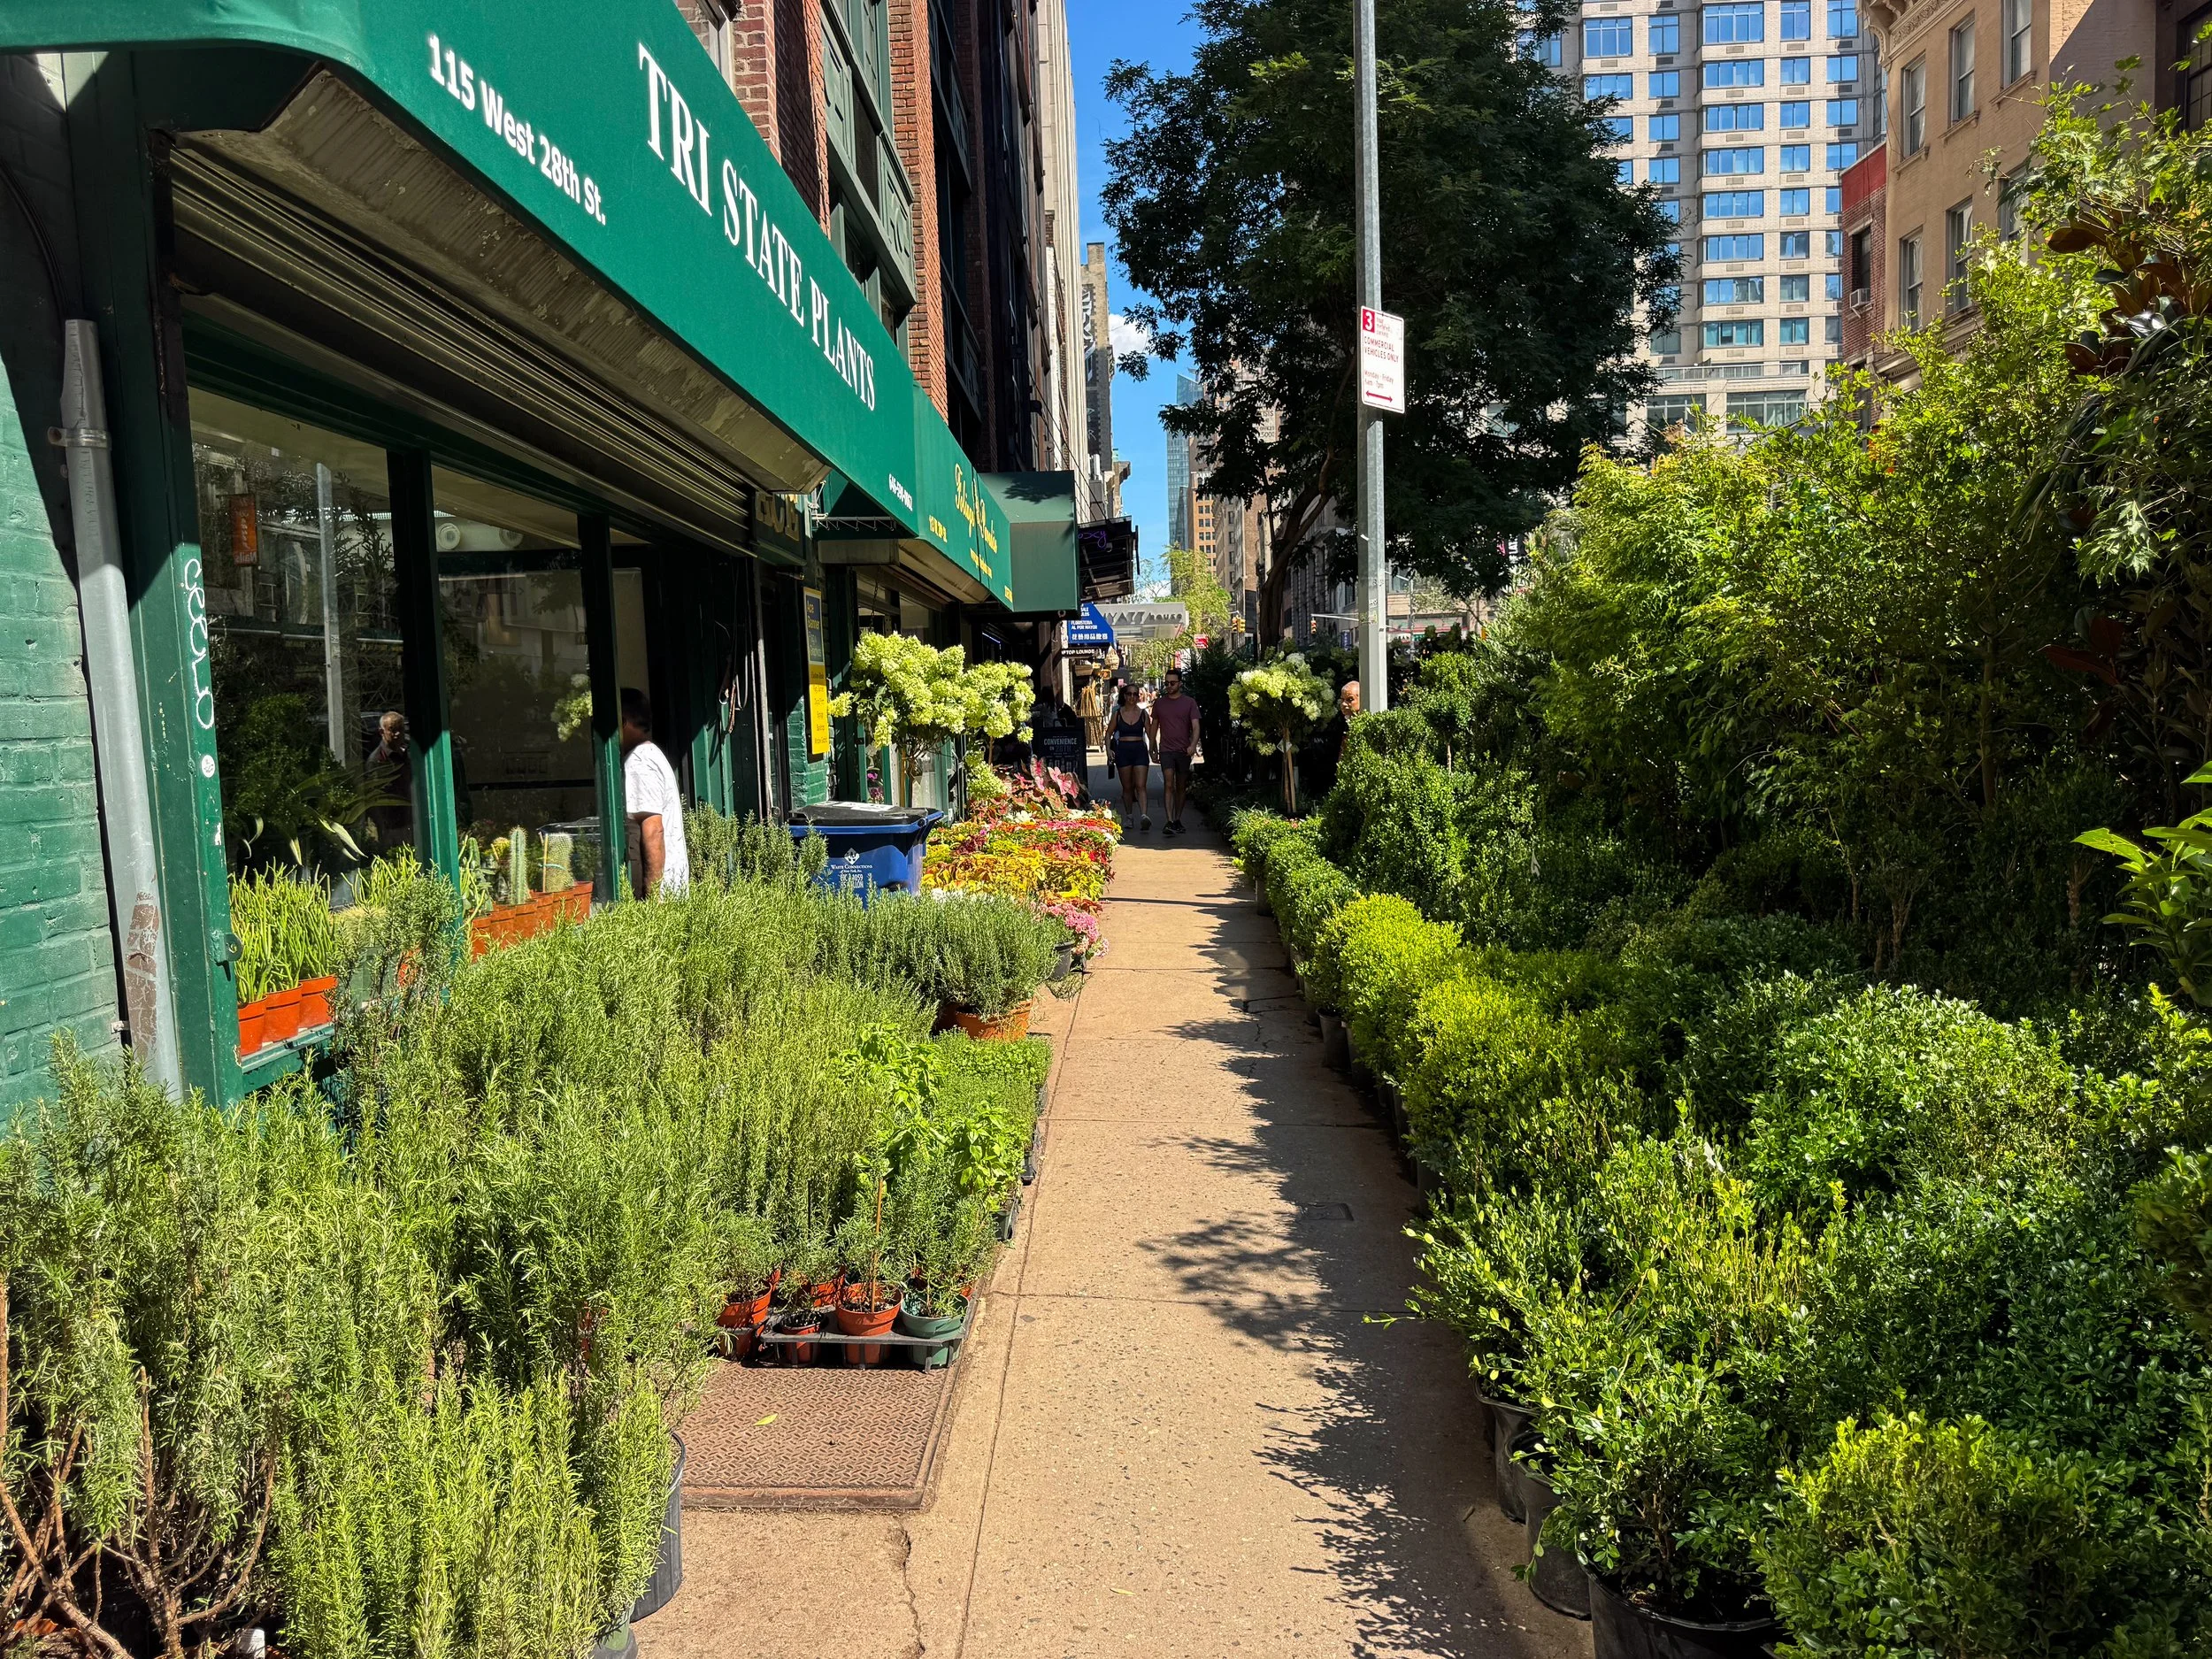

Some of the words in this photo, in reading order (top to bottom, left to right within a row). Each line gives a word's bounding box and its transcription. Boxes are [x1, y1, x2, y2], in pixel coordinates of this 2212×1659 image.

[428, 35, 476, 111] 115
[480, 79, 536, 166] West
[540, 135, 580, 204] 28th
[584, 175, 607, 226] St.
[638, 42, 713, 217] TRI
[722, 158, 805, 327] STATE
[810, 275, 876, 412] PLANTS
[1364, 311, 1373, 331] 3
[1364, 336, 1394, 351] COMMERCIAL
[1364, 347, 1386, 359] VEHICLES
[1386, 352, 1399, 363] ONLY
[1148, 612, 1183, 622] house
